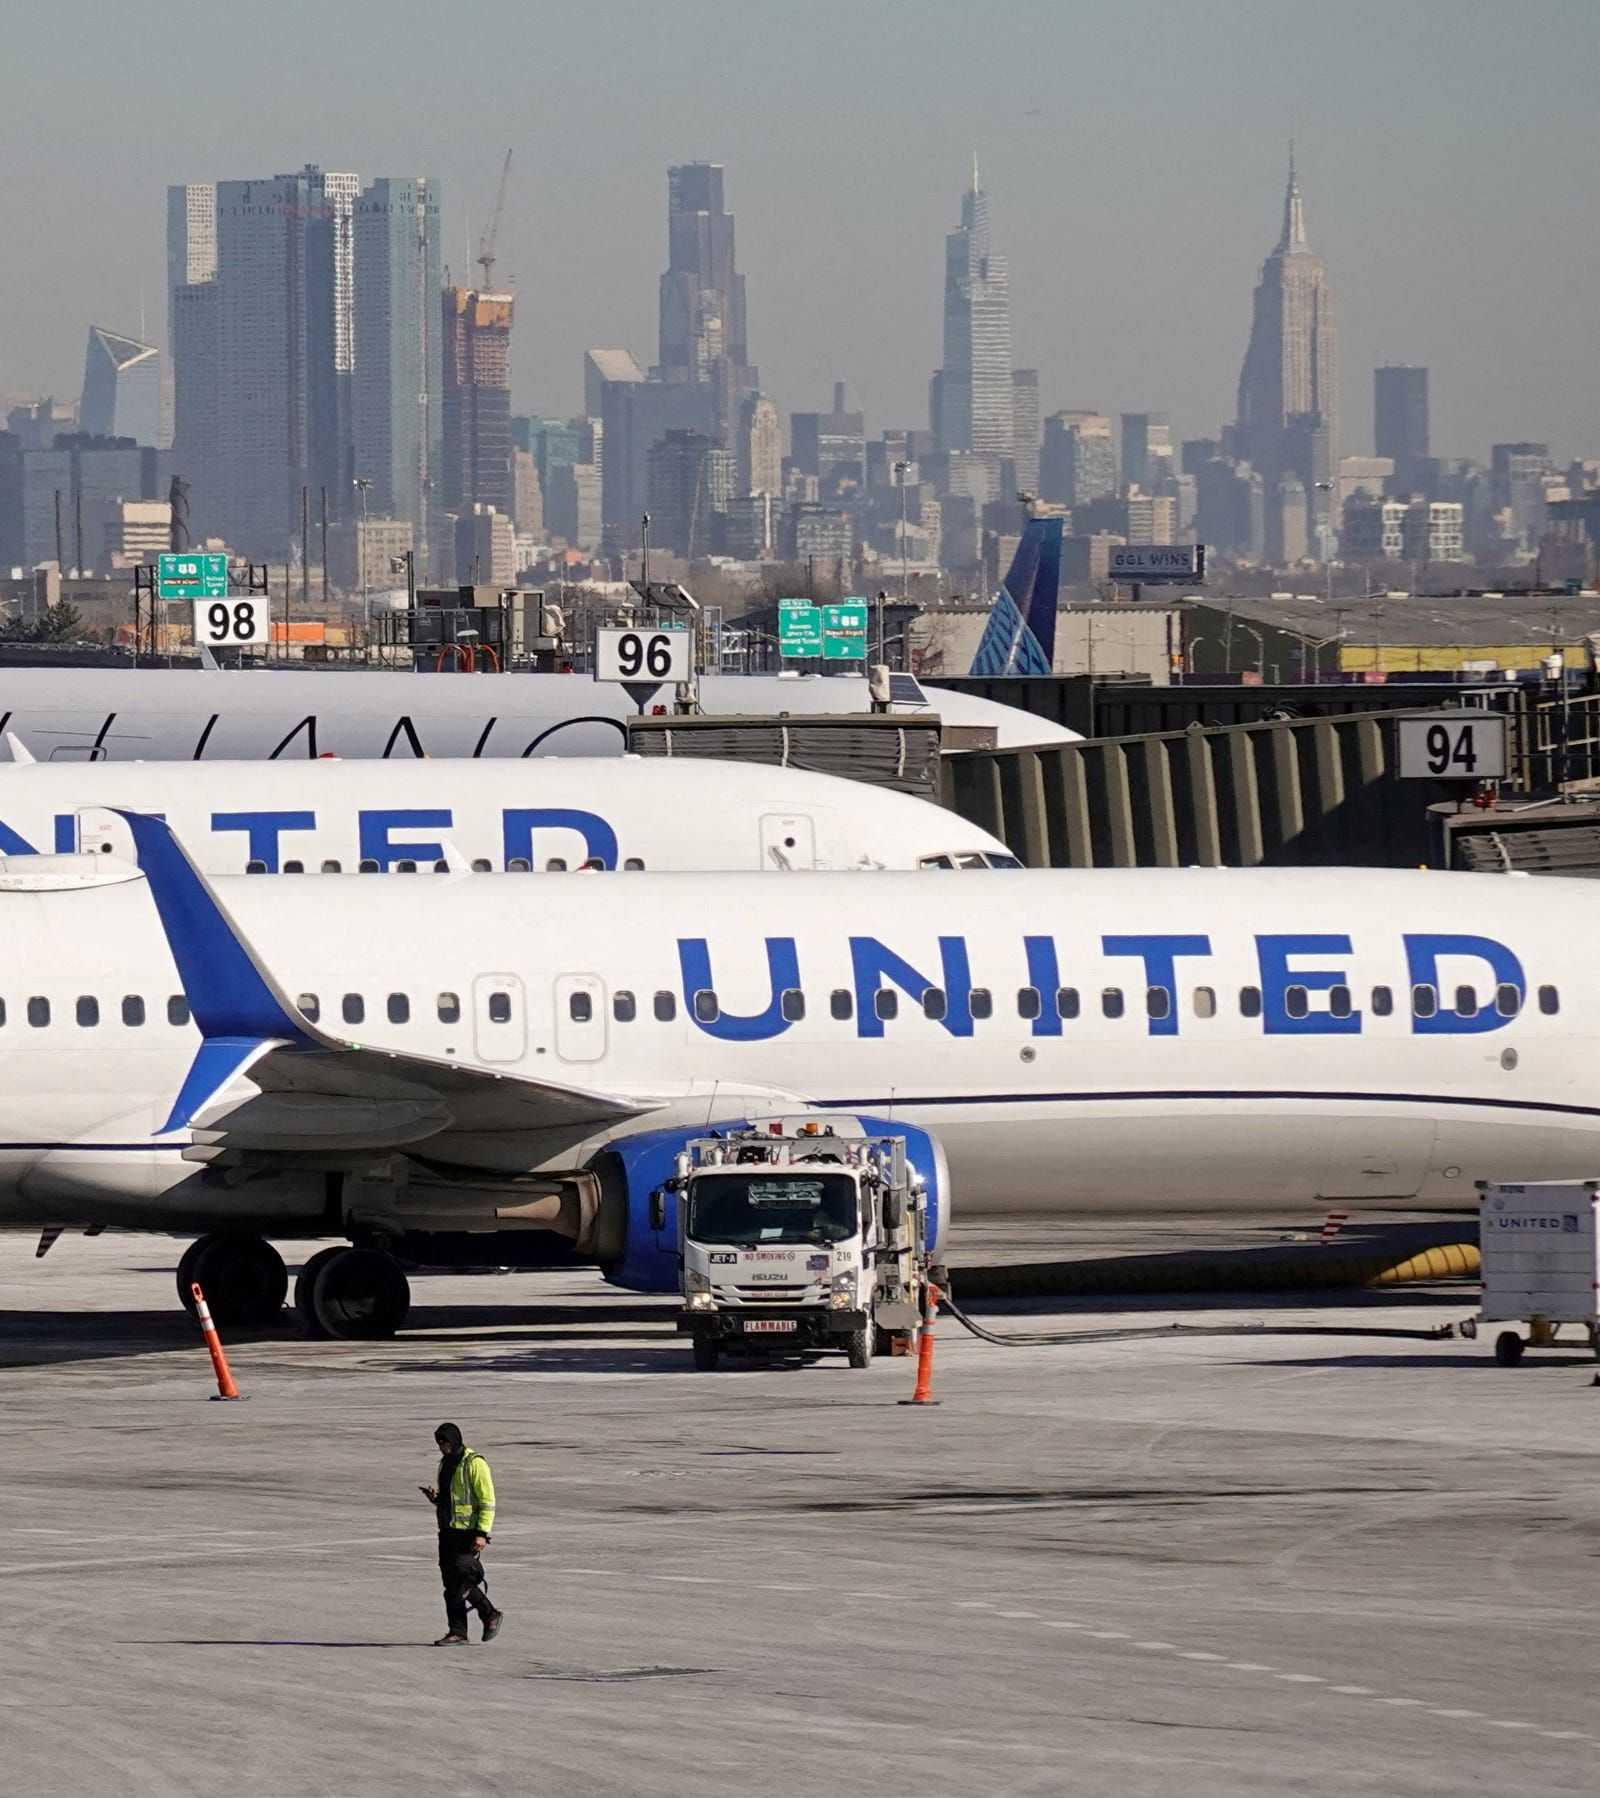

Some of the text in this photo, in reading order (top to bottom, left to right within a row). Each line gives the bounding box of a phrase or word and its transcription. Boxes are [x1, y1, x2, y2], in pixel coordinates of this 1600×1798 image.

[208, 602, 256, 641] 98
[618, 633, 672, 678] 96
[1427, 724, 1477, 774] 94
[678, 934, 1526, 1041] UNITED
[1499, 1218, 1560, 1229] UNITED
[745, 1252, 786, 1261] NO SMOKING
[745, 1321, 797, 1332] FLAMMABLE
